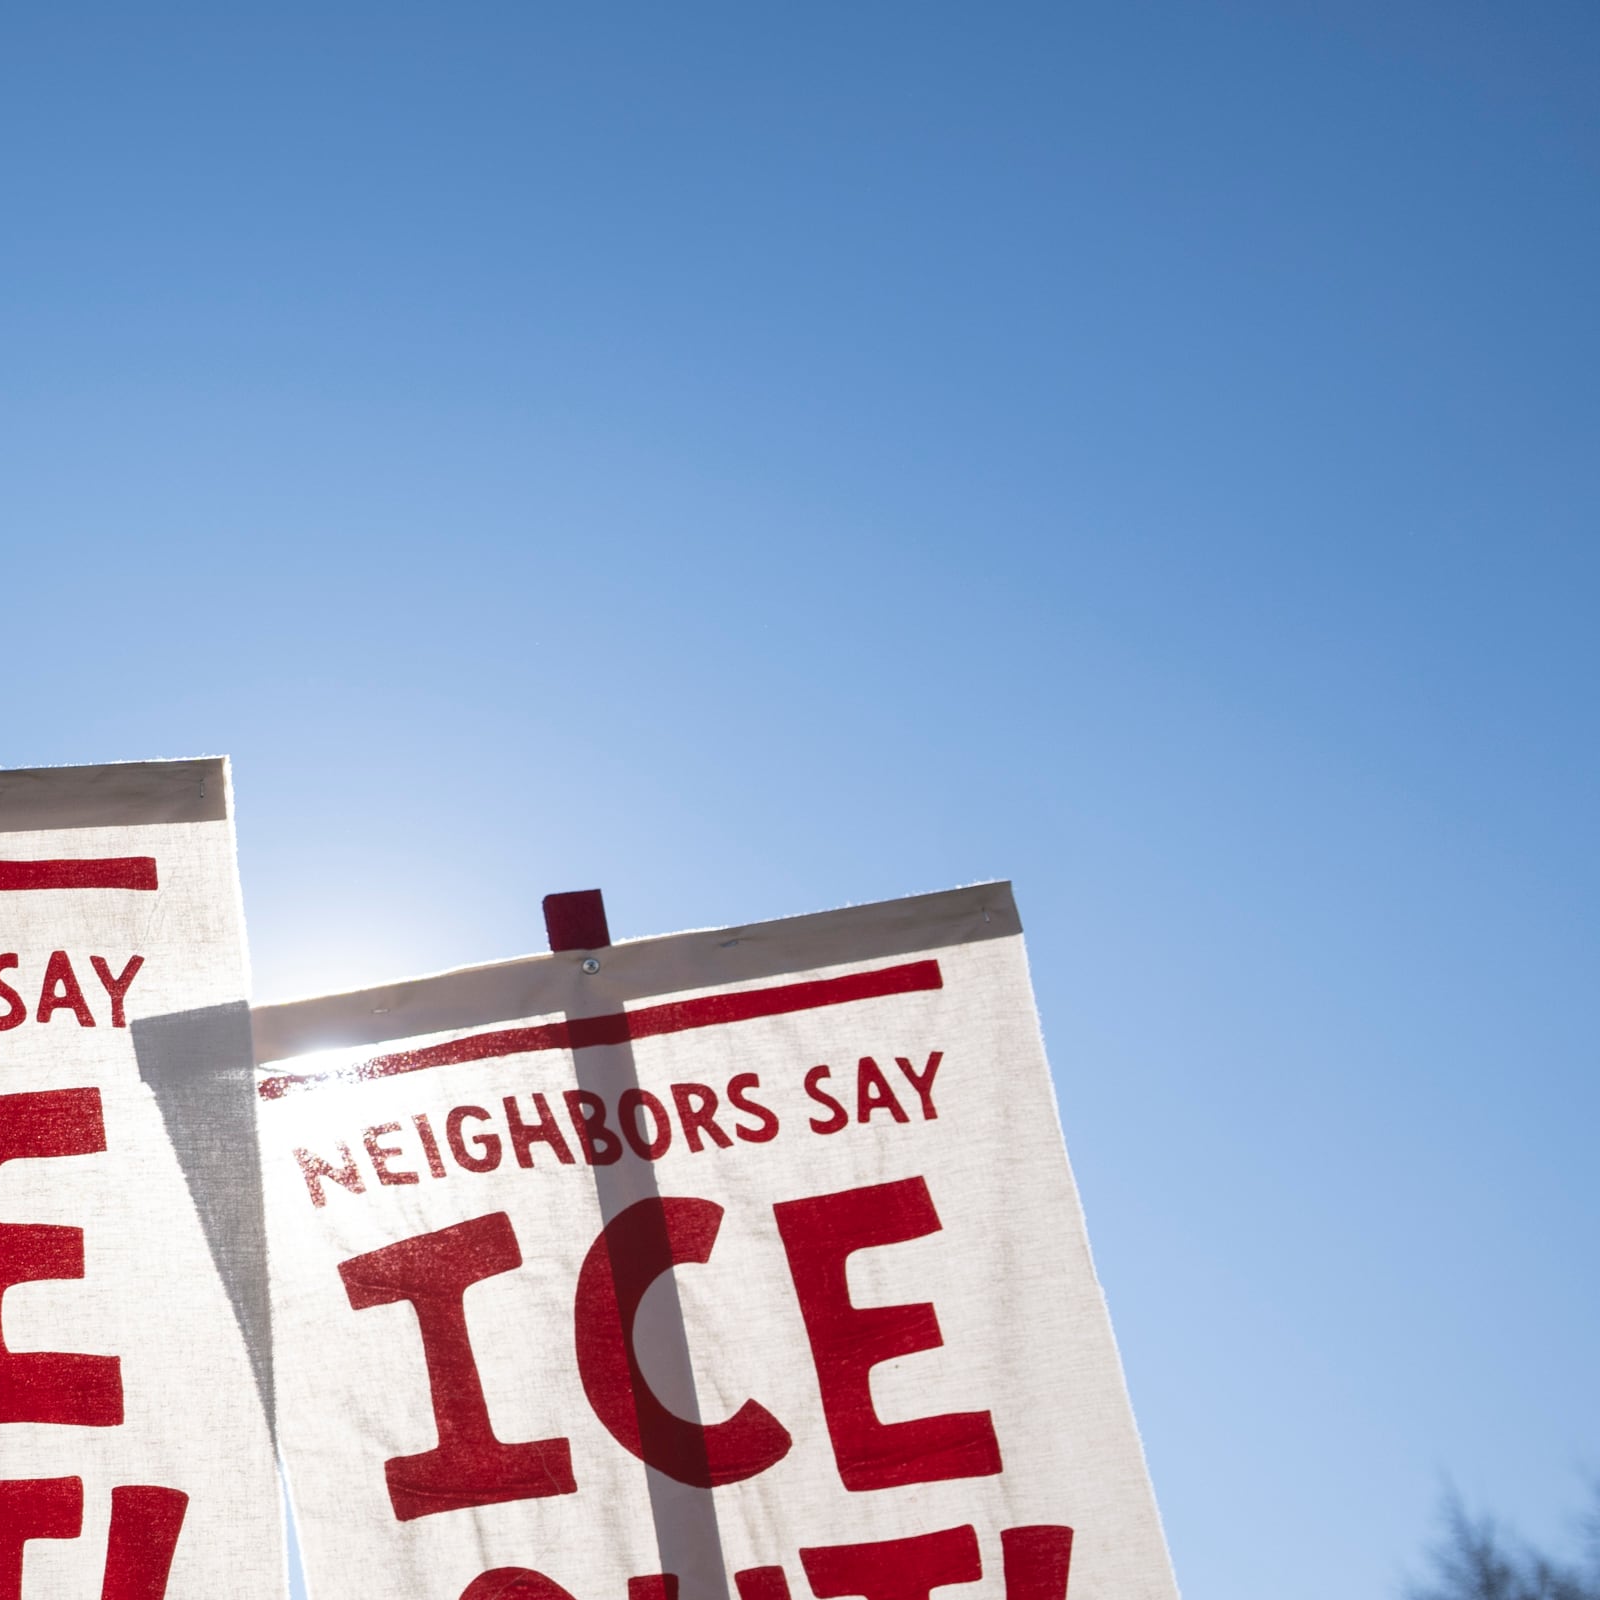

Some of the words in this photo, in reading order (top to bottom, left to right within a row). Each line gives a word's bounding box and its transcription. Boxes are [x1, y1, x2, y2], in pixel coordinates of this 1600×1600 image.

[291, 1071, 779, 1208] NEIGHBORS
[804, 1051, 944, 1136] SAY
[335, 1175, 1003, 1523] ICE
